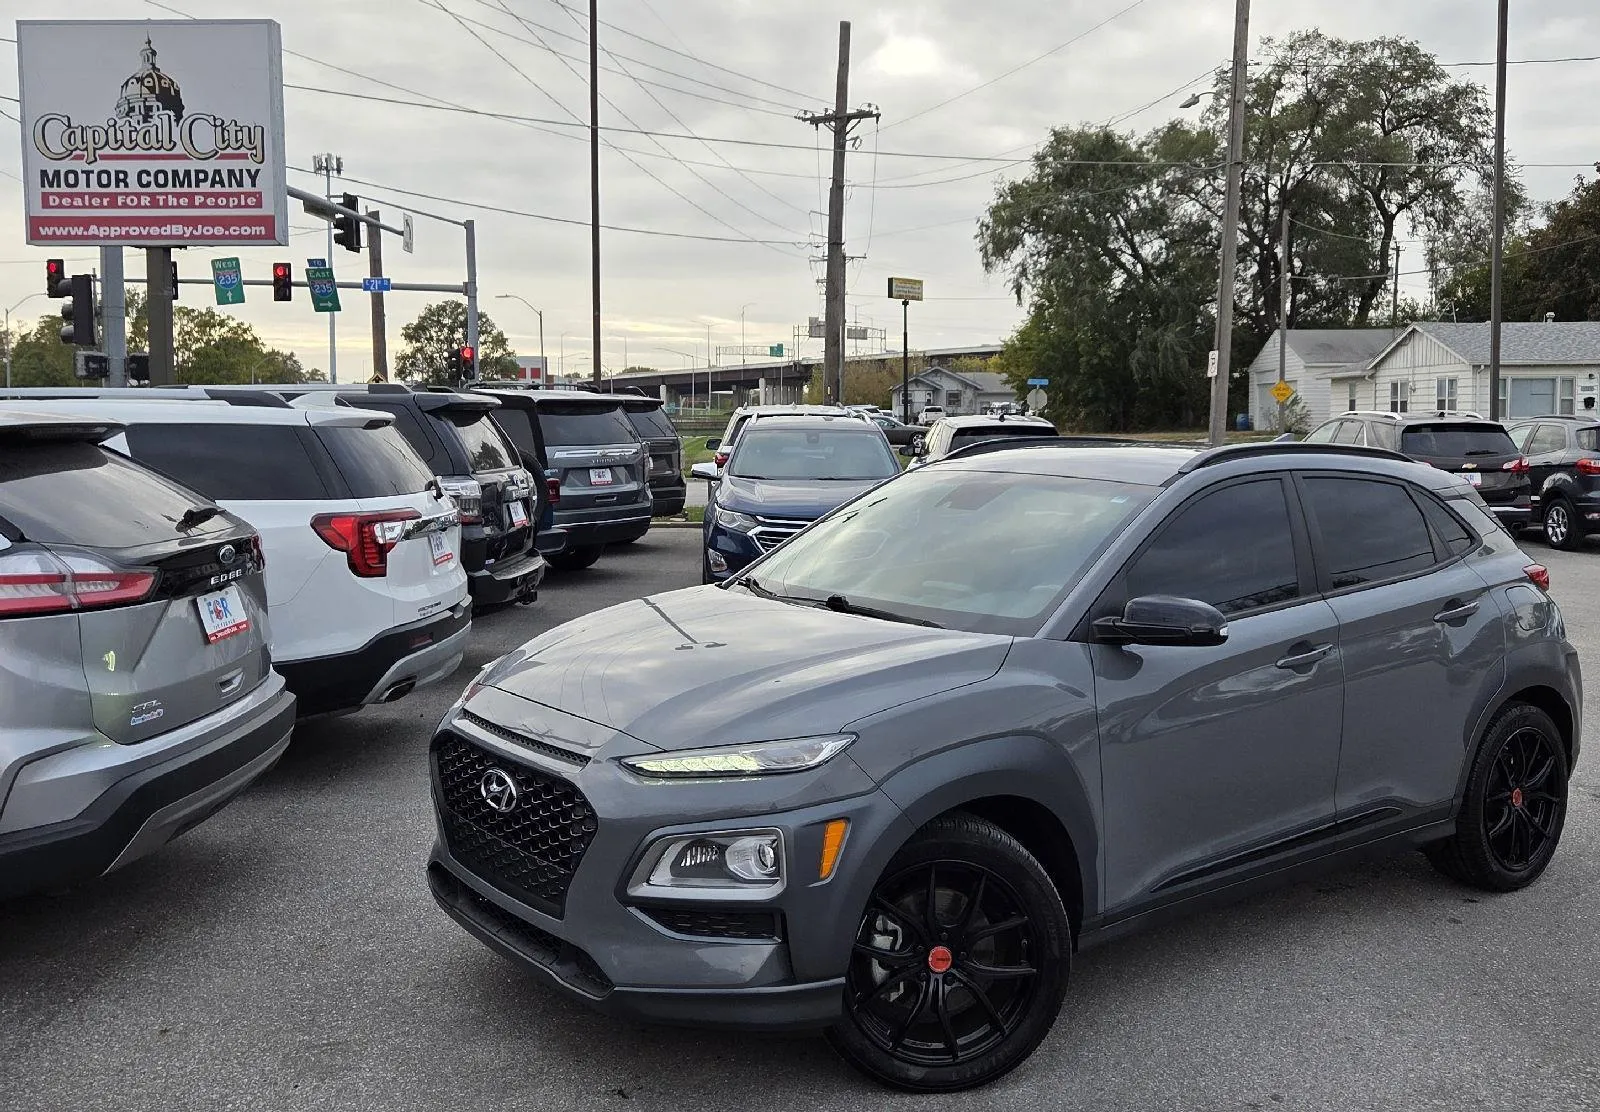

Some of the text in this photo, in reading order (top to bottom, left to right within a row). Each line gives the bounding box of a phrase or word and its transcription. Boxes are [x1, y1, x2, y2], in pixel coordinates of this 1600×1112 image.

[33, 113, 265, 164] Capital City
[40, 168, 262, 189] MOTOR COMPANY
[49, 195, 110, 207] Dealer
[117, 195, 150, 207] FOR
[156, 194, 189, 206] The
[39, 224, 266, 237] www.ApprovedByJoe.com
[219, 274, 238, 285] 235
[314, 284, 333, 293] 235
[210, 569, 243, 585] EDGE
